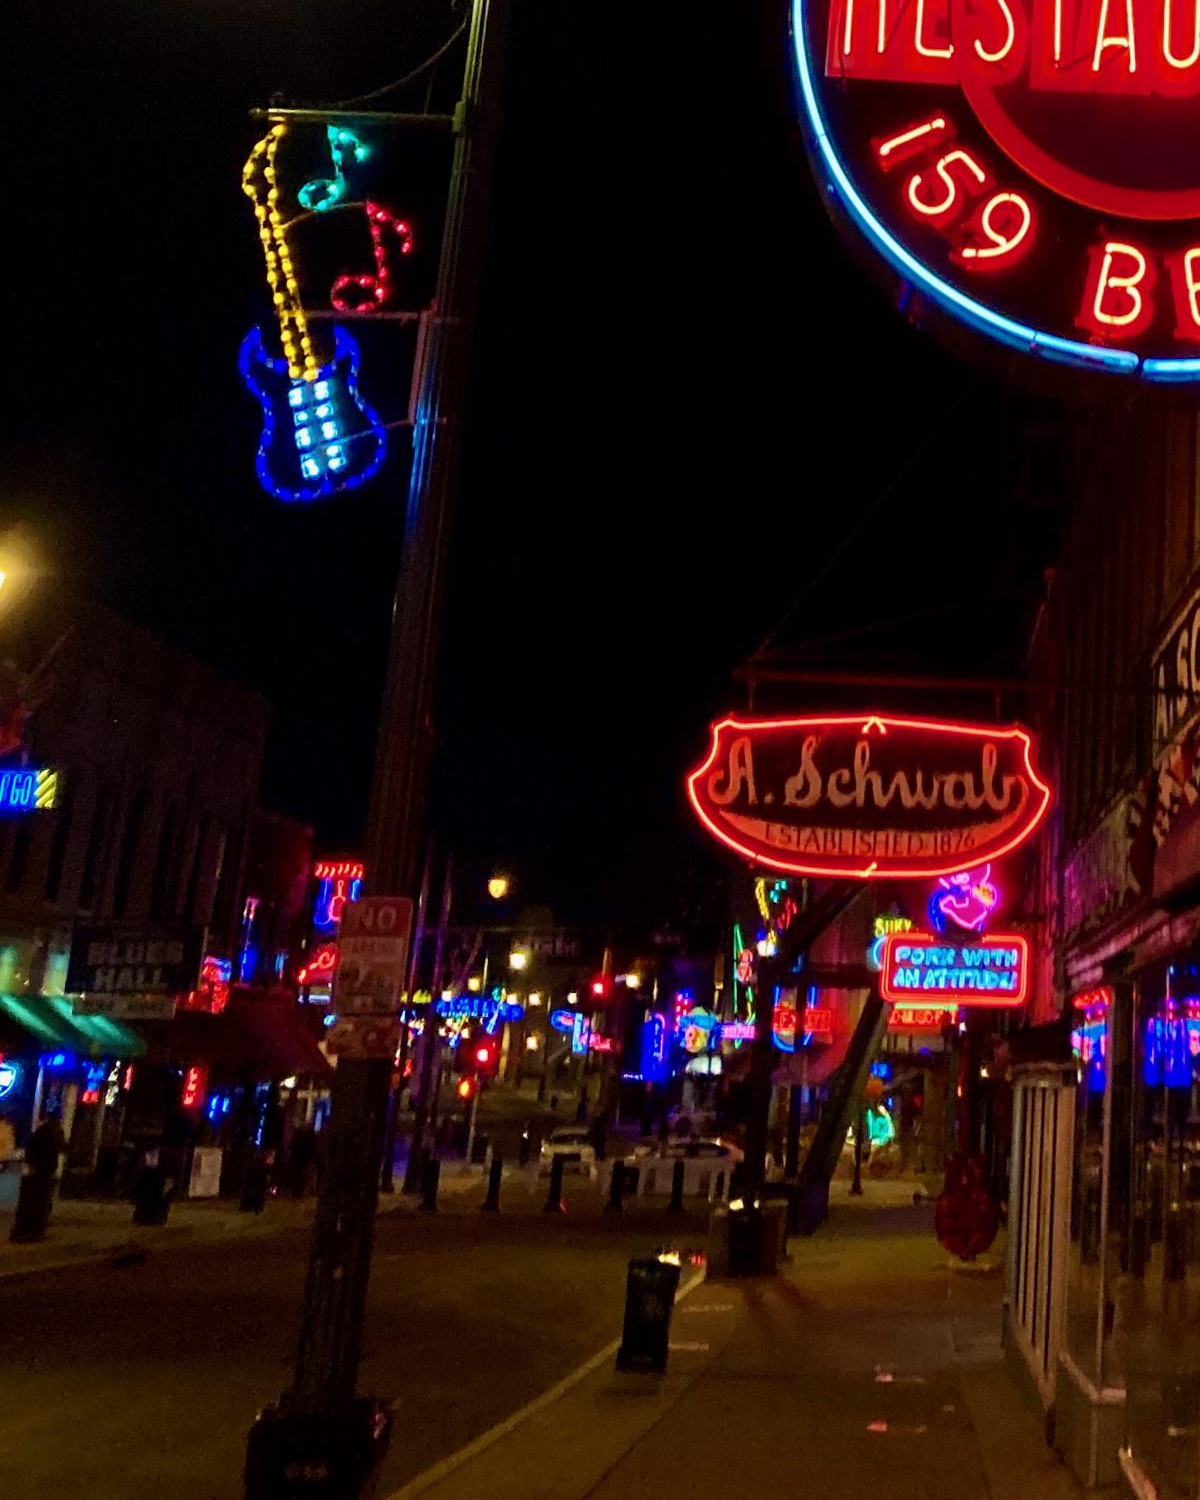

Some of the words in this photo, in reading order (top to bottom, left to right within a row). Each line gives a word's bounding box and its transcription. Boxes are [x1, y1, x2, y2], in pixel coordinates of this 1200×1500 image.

[879, 118, 1032, 259] 159
[707, 735, 775, 806] A.
[782, 734, 1026, 811] Schwab
[764, 822, 925, 857] ESTABLISHED
[894, 946, 956, 966] PORK
[961, 947, 1018, 967] WITH
[893, 967, 920, 989] AN
